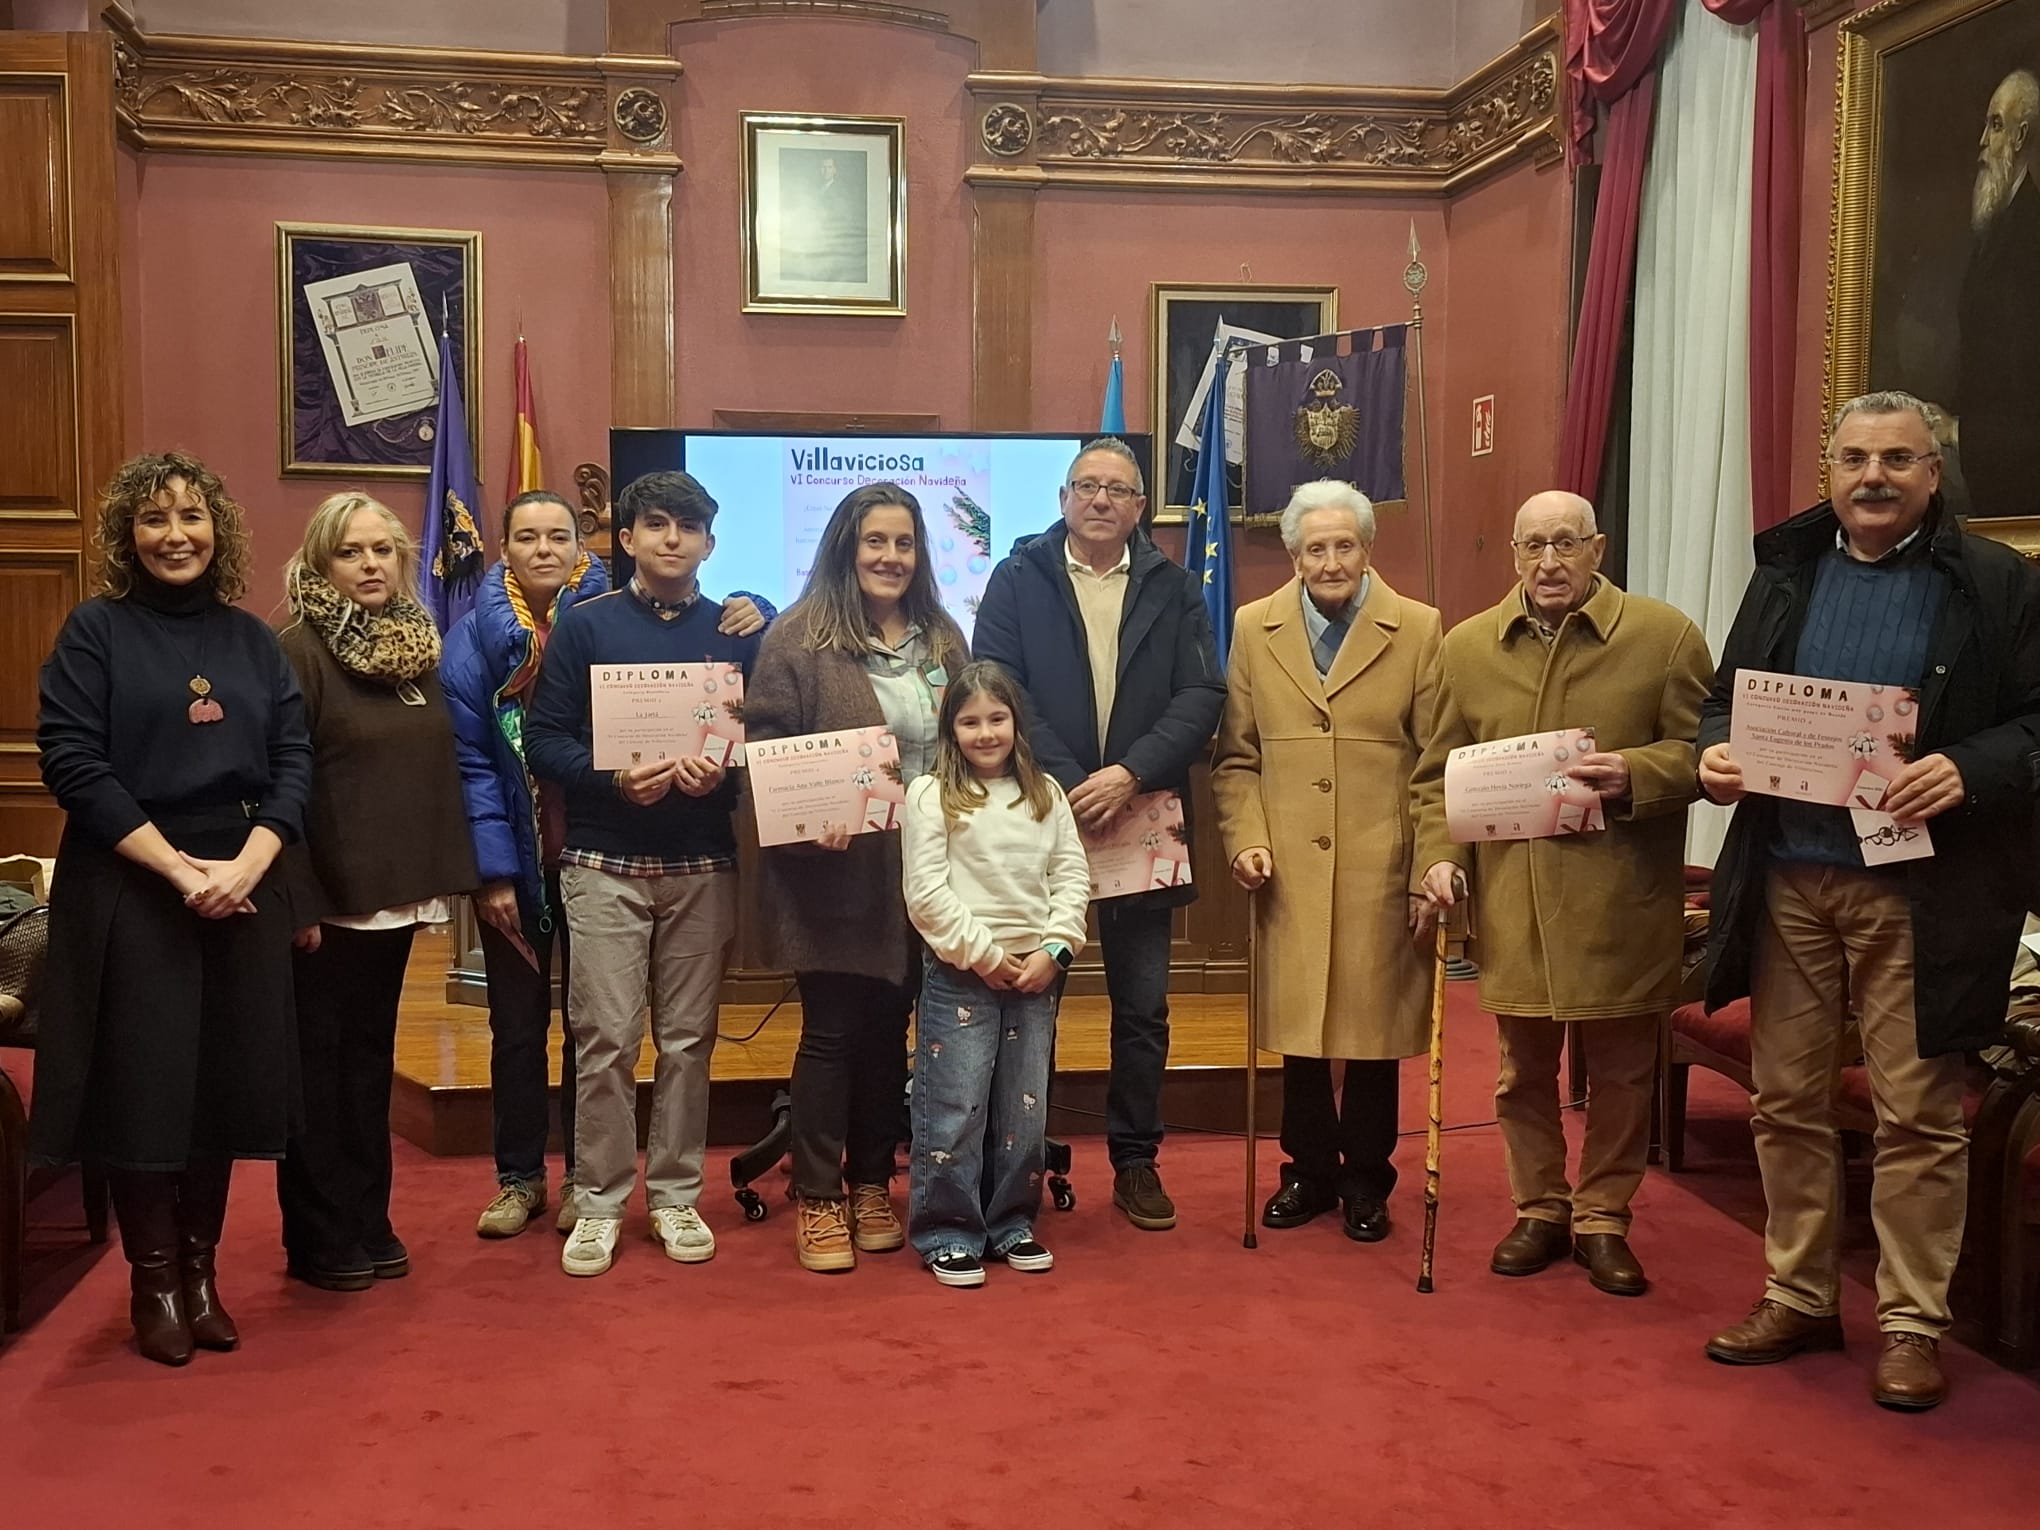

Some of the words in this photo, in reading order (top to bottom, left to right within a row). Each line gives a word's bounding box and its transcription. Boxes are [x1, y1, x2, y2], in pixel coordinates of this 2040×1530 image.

[790, 447, 924, 471] Villaviciosa
[790, 474, 802, 485] VI
[806, 474, 854, 485] Concurso
[919, 475, 967, 487] Navideña
[603, 670, 688, 681] DIPLOMA
[1747, 678, 1849, 702] DIPLOMA
[758, 738, 842, 757] DIPLOMA
[1458, 741, 1538, 759] DIPLOMA
